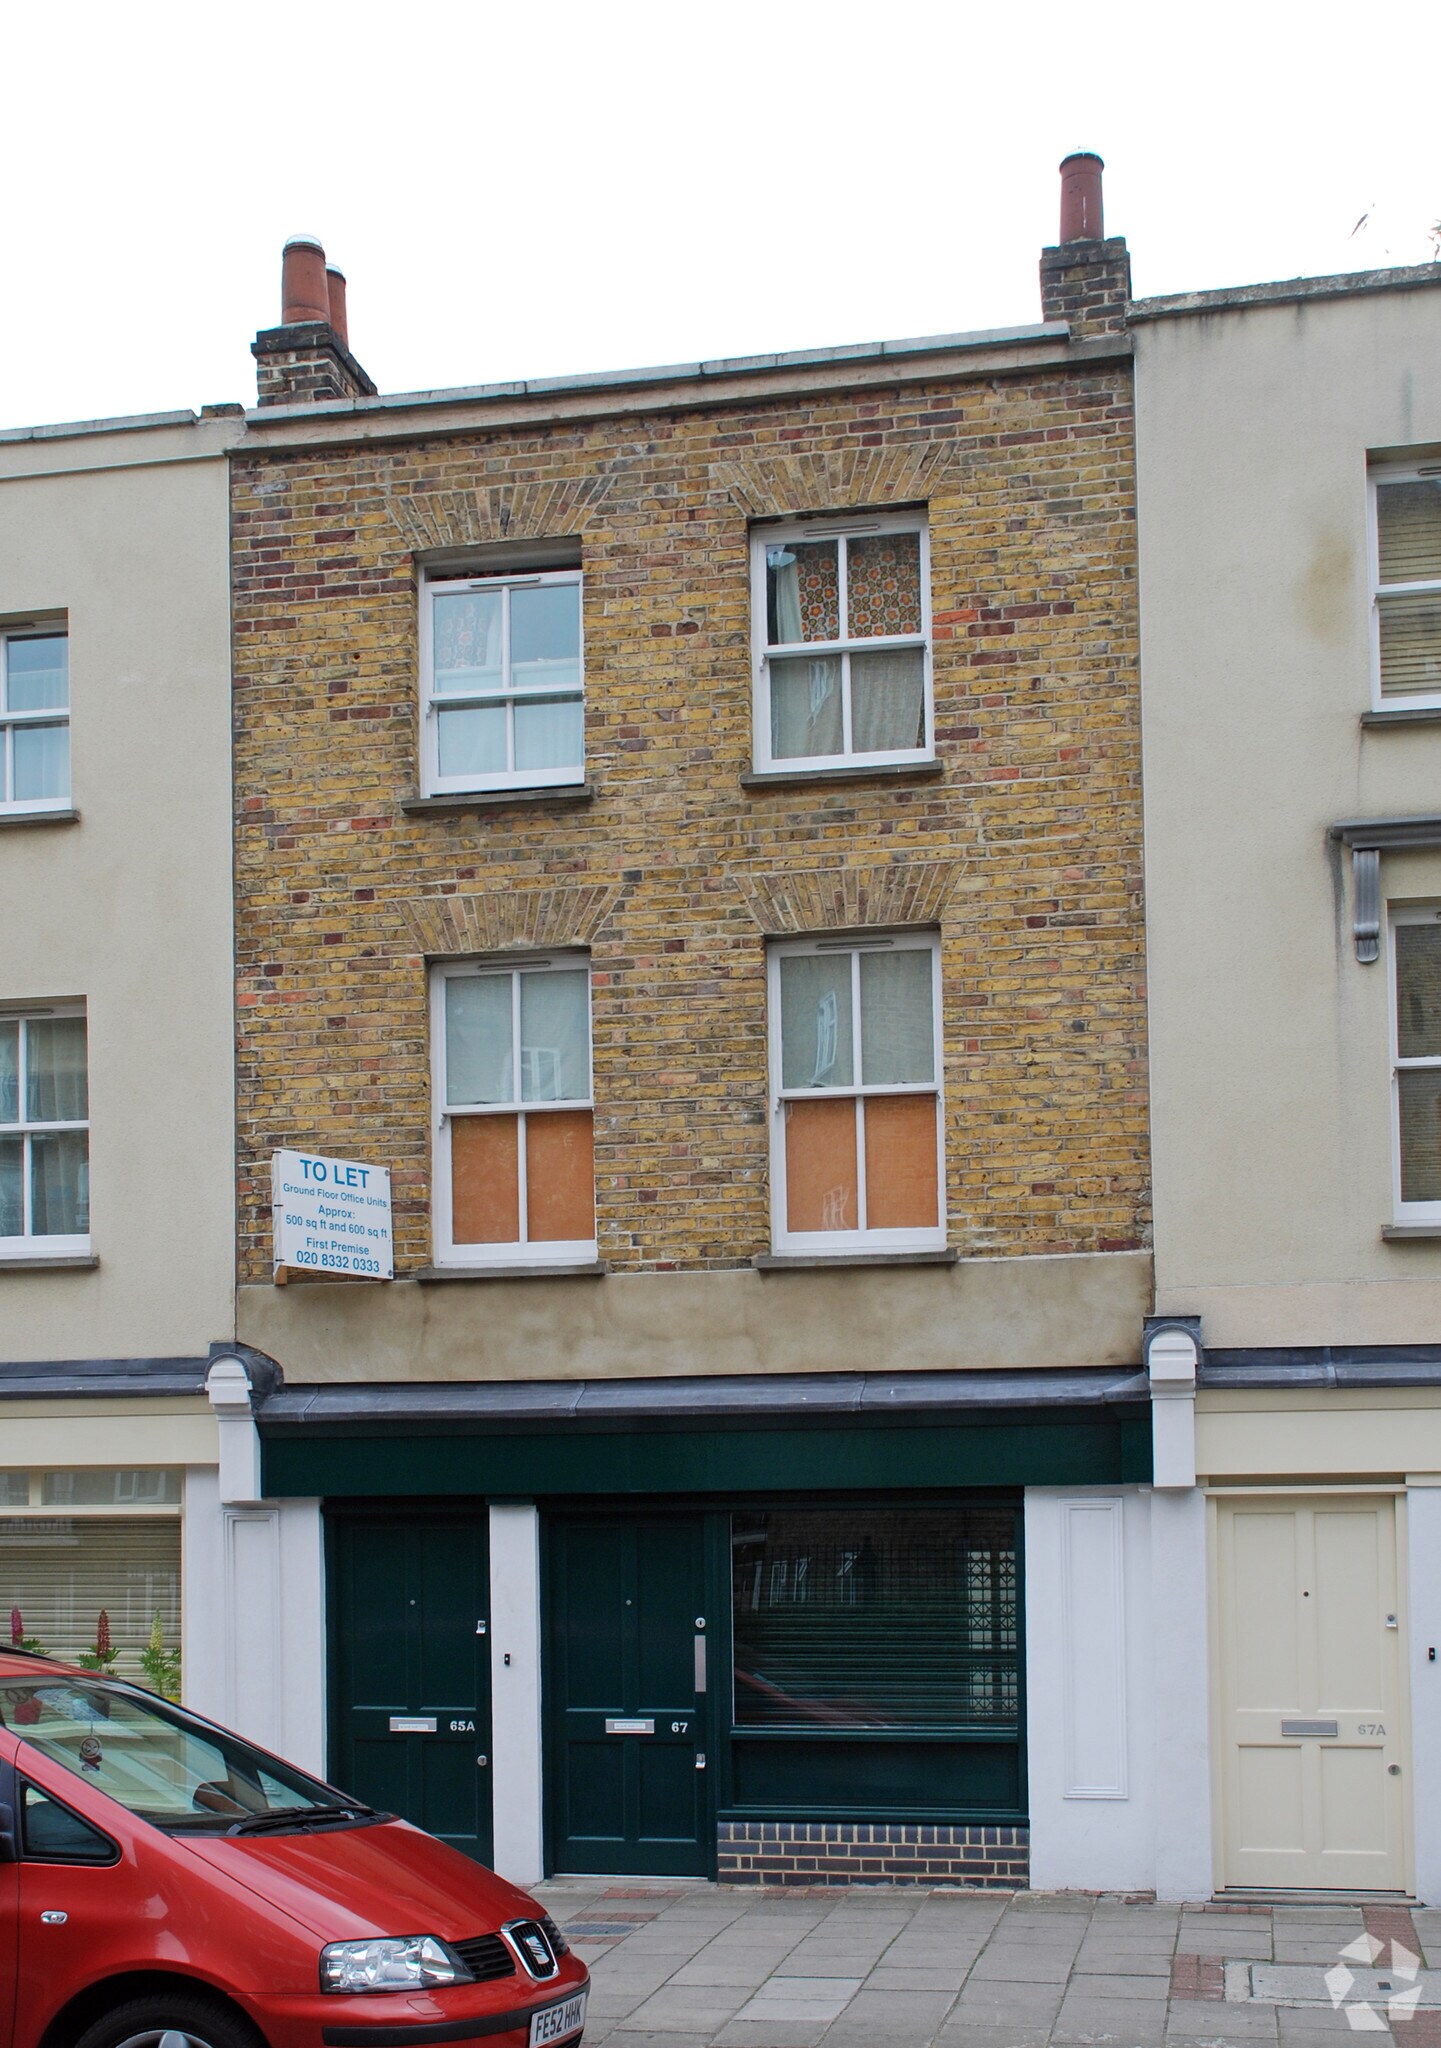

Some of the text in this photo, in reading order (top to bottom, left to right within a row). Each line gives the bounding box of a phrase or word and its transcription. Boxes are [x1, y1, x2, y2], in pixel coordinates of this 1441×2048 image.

[300, 1159, 370, 1188] TO LET
[283, 1183, 387, 1208] Ground Floor Office Units
[318, 1205, 356, 1219] Approx:
[286, 1214, 388, 1238] 500 sq ft and 600 sq ft
[306, 1237, 370, 1255] First Premise
[296, 1250, 380, 1272] 020 8332 0333
[450, 1720, 475, 1731] 65A
[671, 1722, 688, 1733] 67
[1358, 1724, 1386, 1736] 67A
[536, 1998, 582, 2041] FE52 HHK
